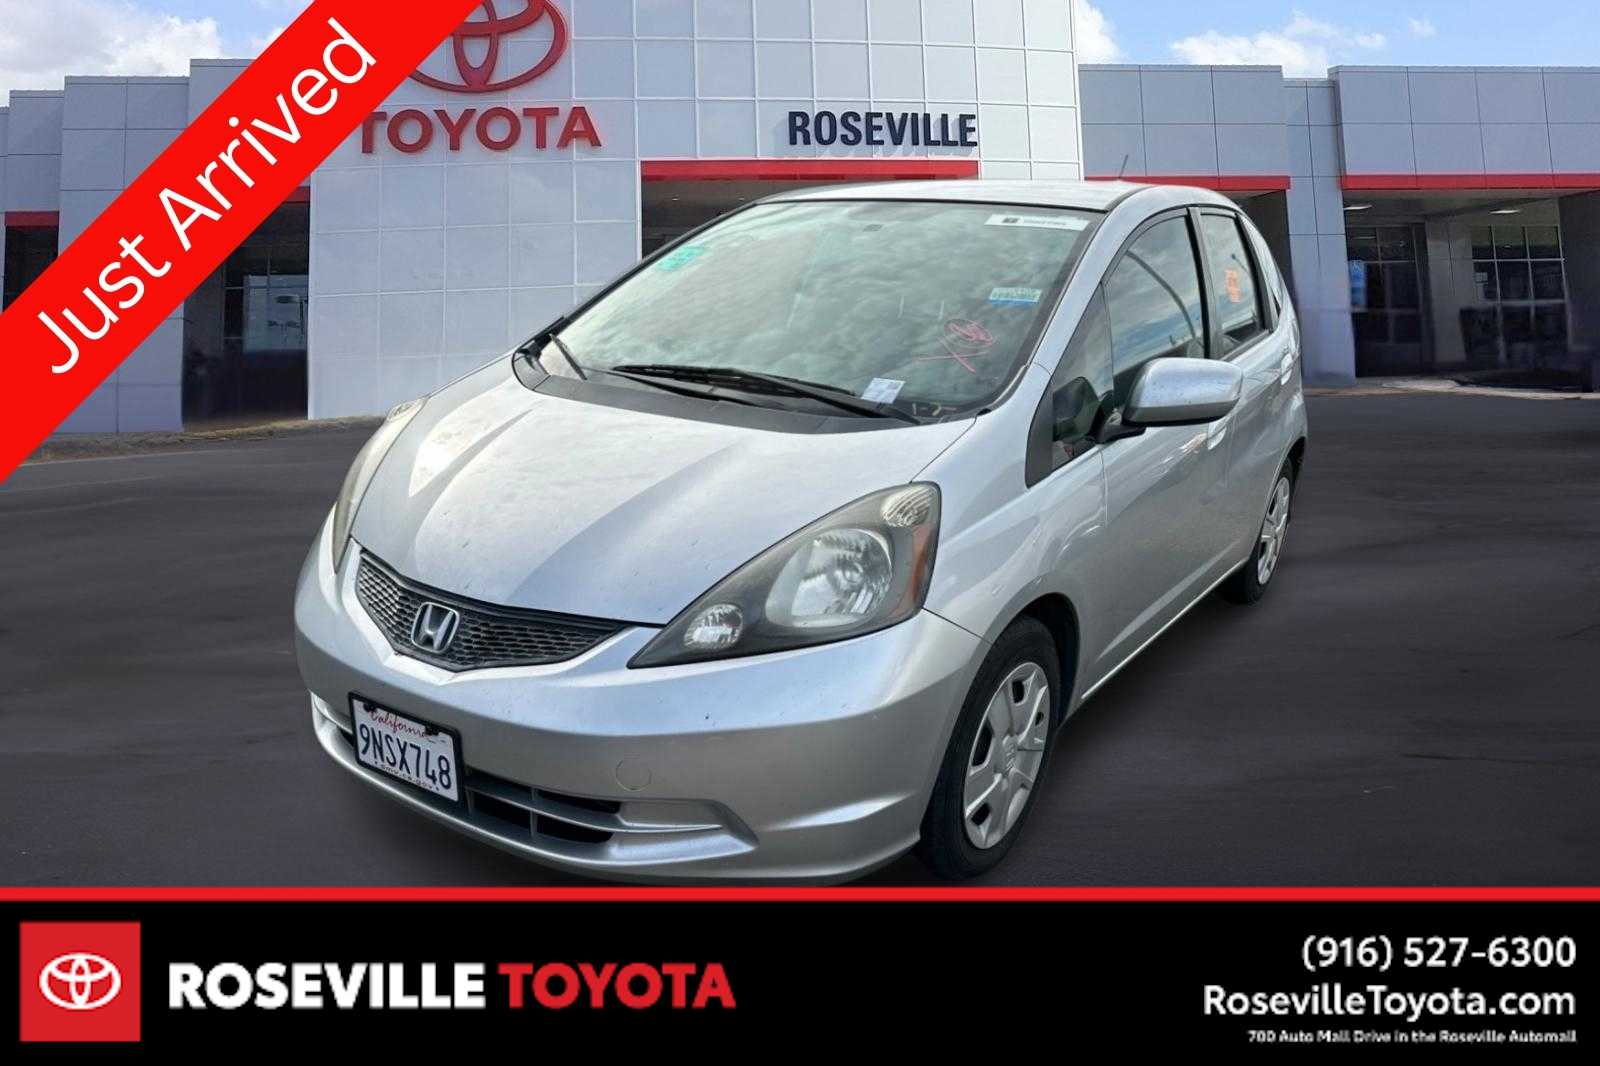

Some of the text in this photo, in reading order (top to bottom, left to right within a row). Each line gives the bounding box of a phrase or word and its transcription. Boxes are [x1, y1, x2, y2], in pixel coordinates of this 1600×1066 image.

[361, 106, 602, 154] TOYOTA
[788, 110, 978, 147] ROSEVILLE
[359, 723, 452, 790] 9NSX748
